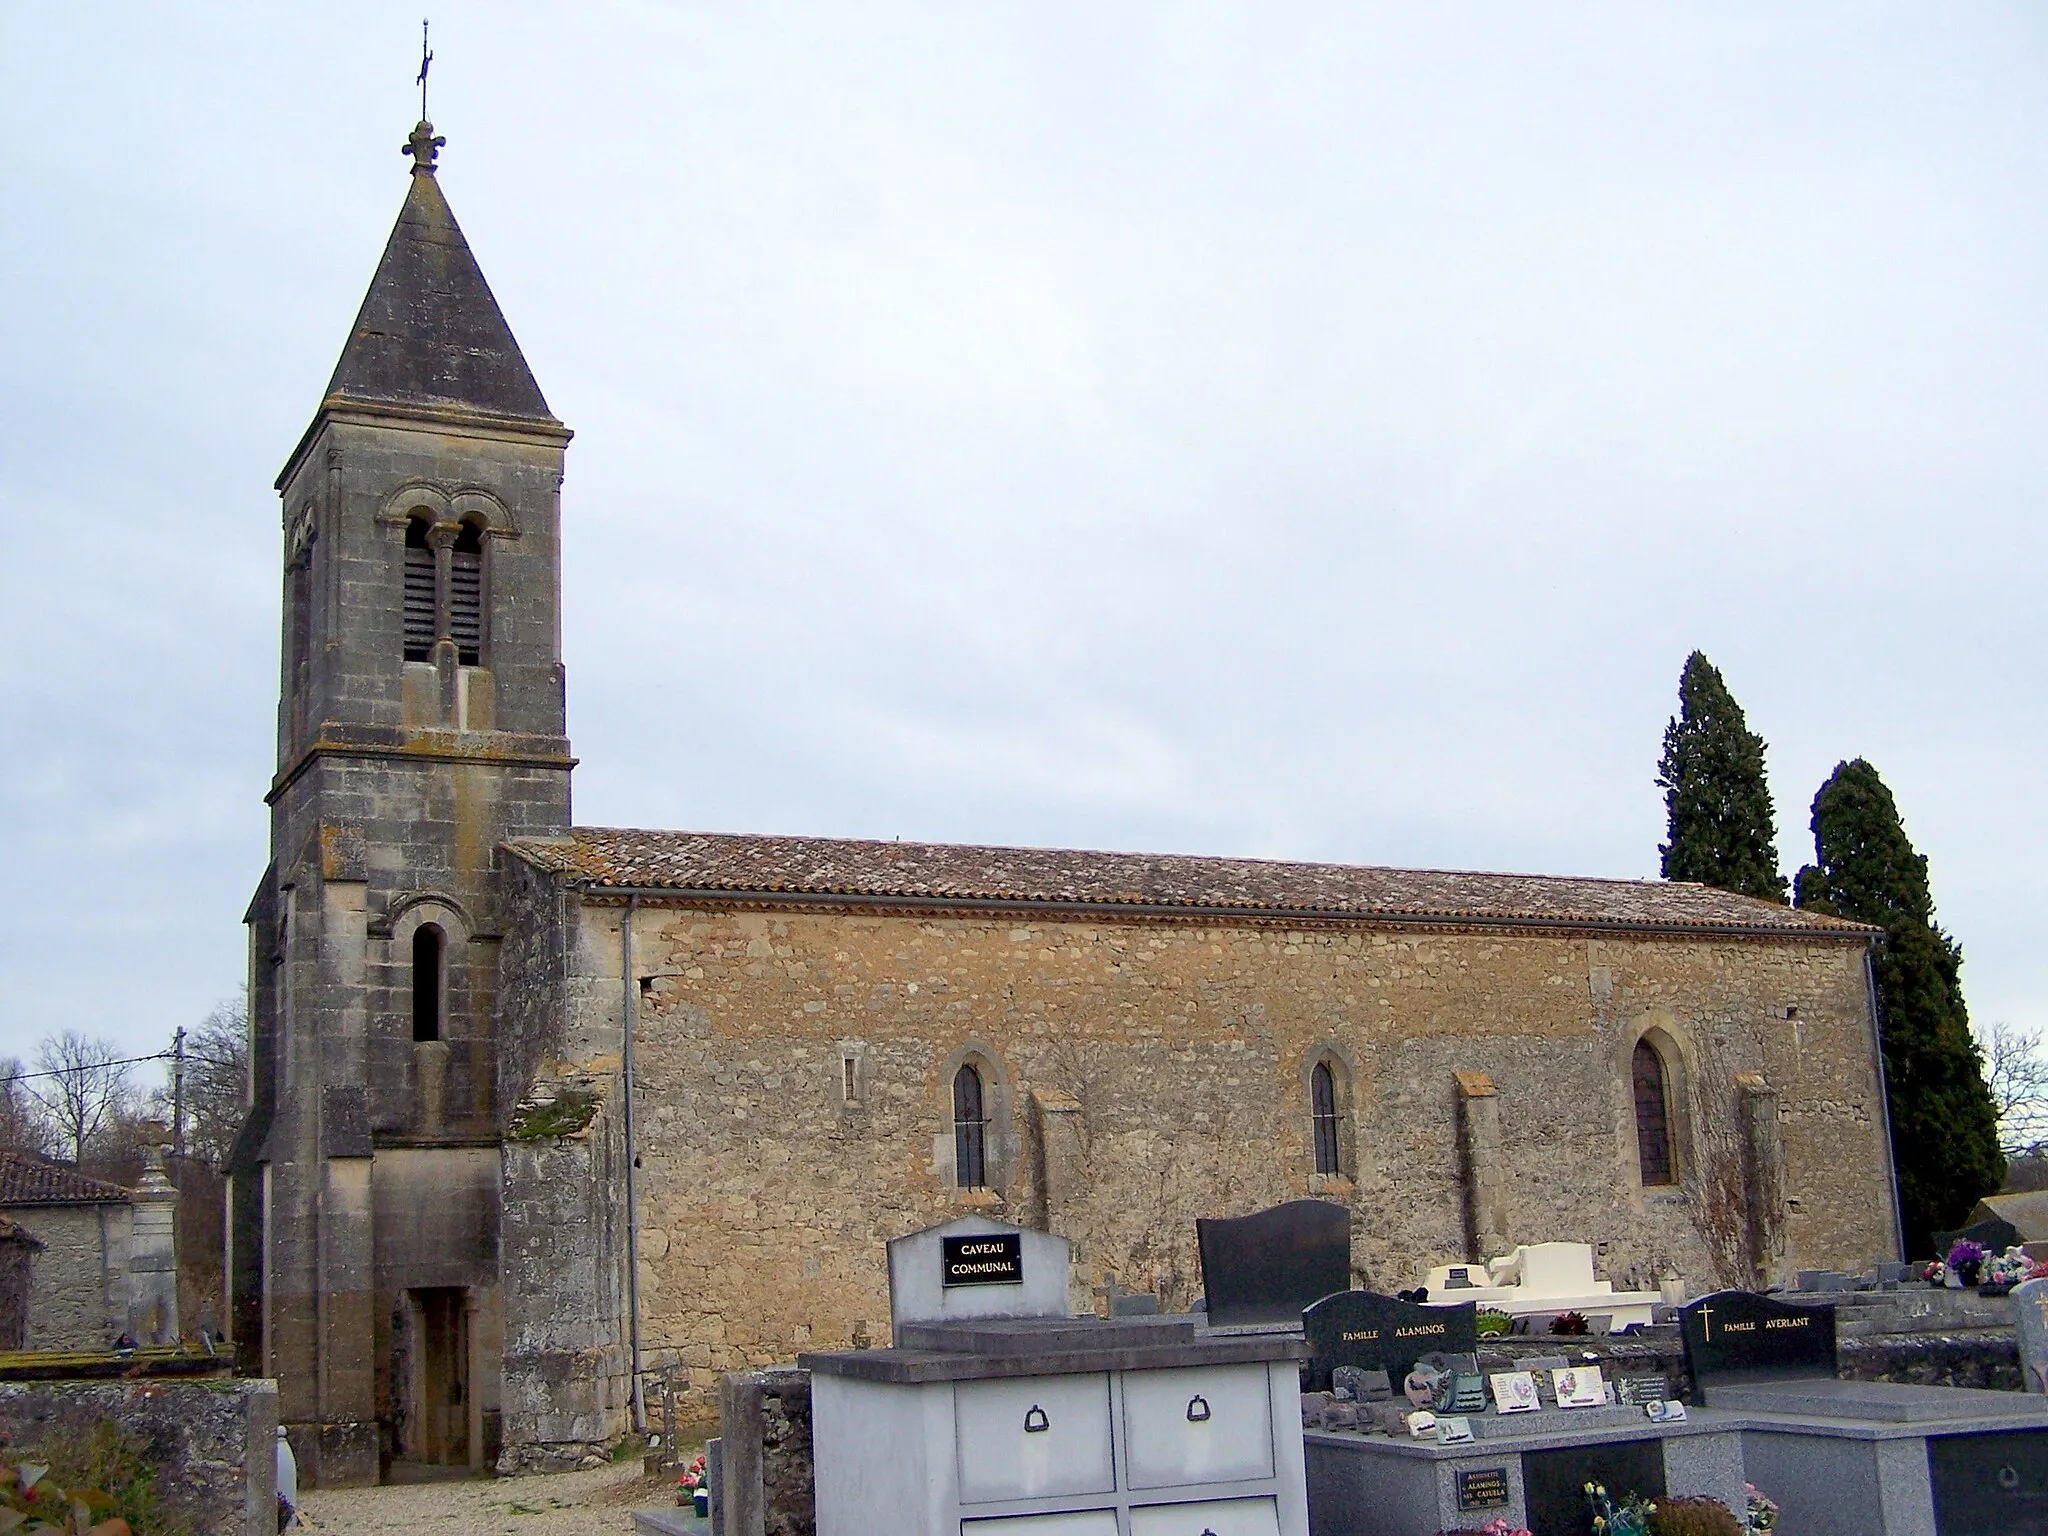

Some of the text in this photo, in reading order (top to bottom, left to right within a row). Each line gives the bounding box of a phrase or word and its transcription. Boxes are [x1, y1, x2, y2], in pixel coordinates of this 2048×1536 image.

[961, 1243, 1004, 1255] CAVEAU
[951, 1261, 1015, 1275] COMMUNAL
[1724, 1317, 1809, 1332] FAMILLE AVERLANT
[1343, 1323, 1445, 1341] FAMILLE ALAMINOS
[1468, 1480, 1501, 1490] ALAMINOS
